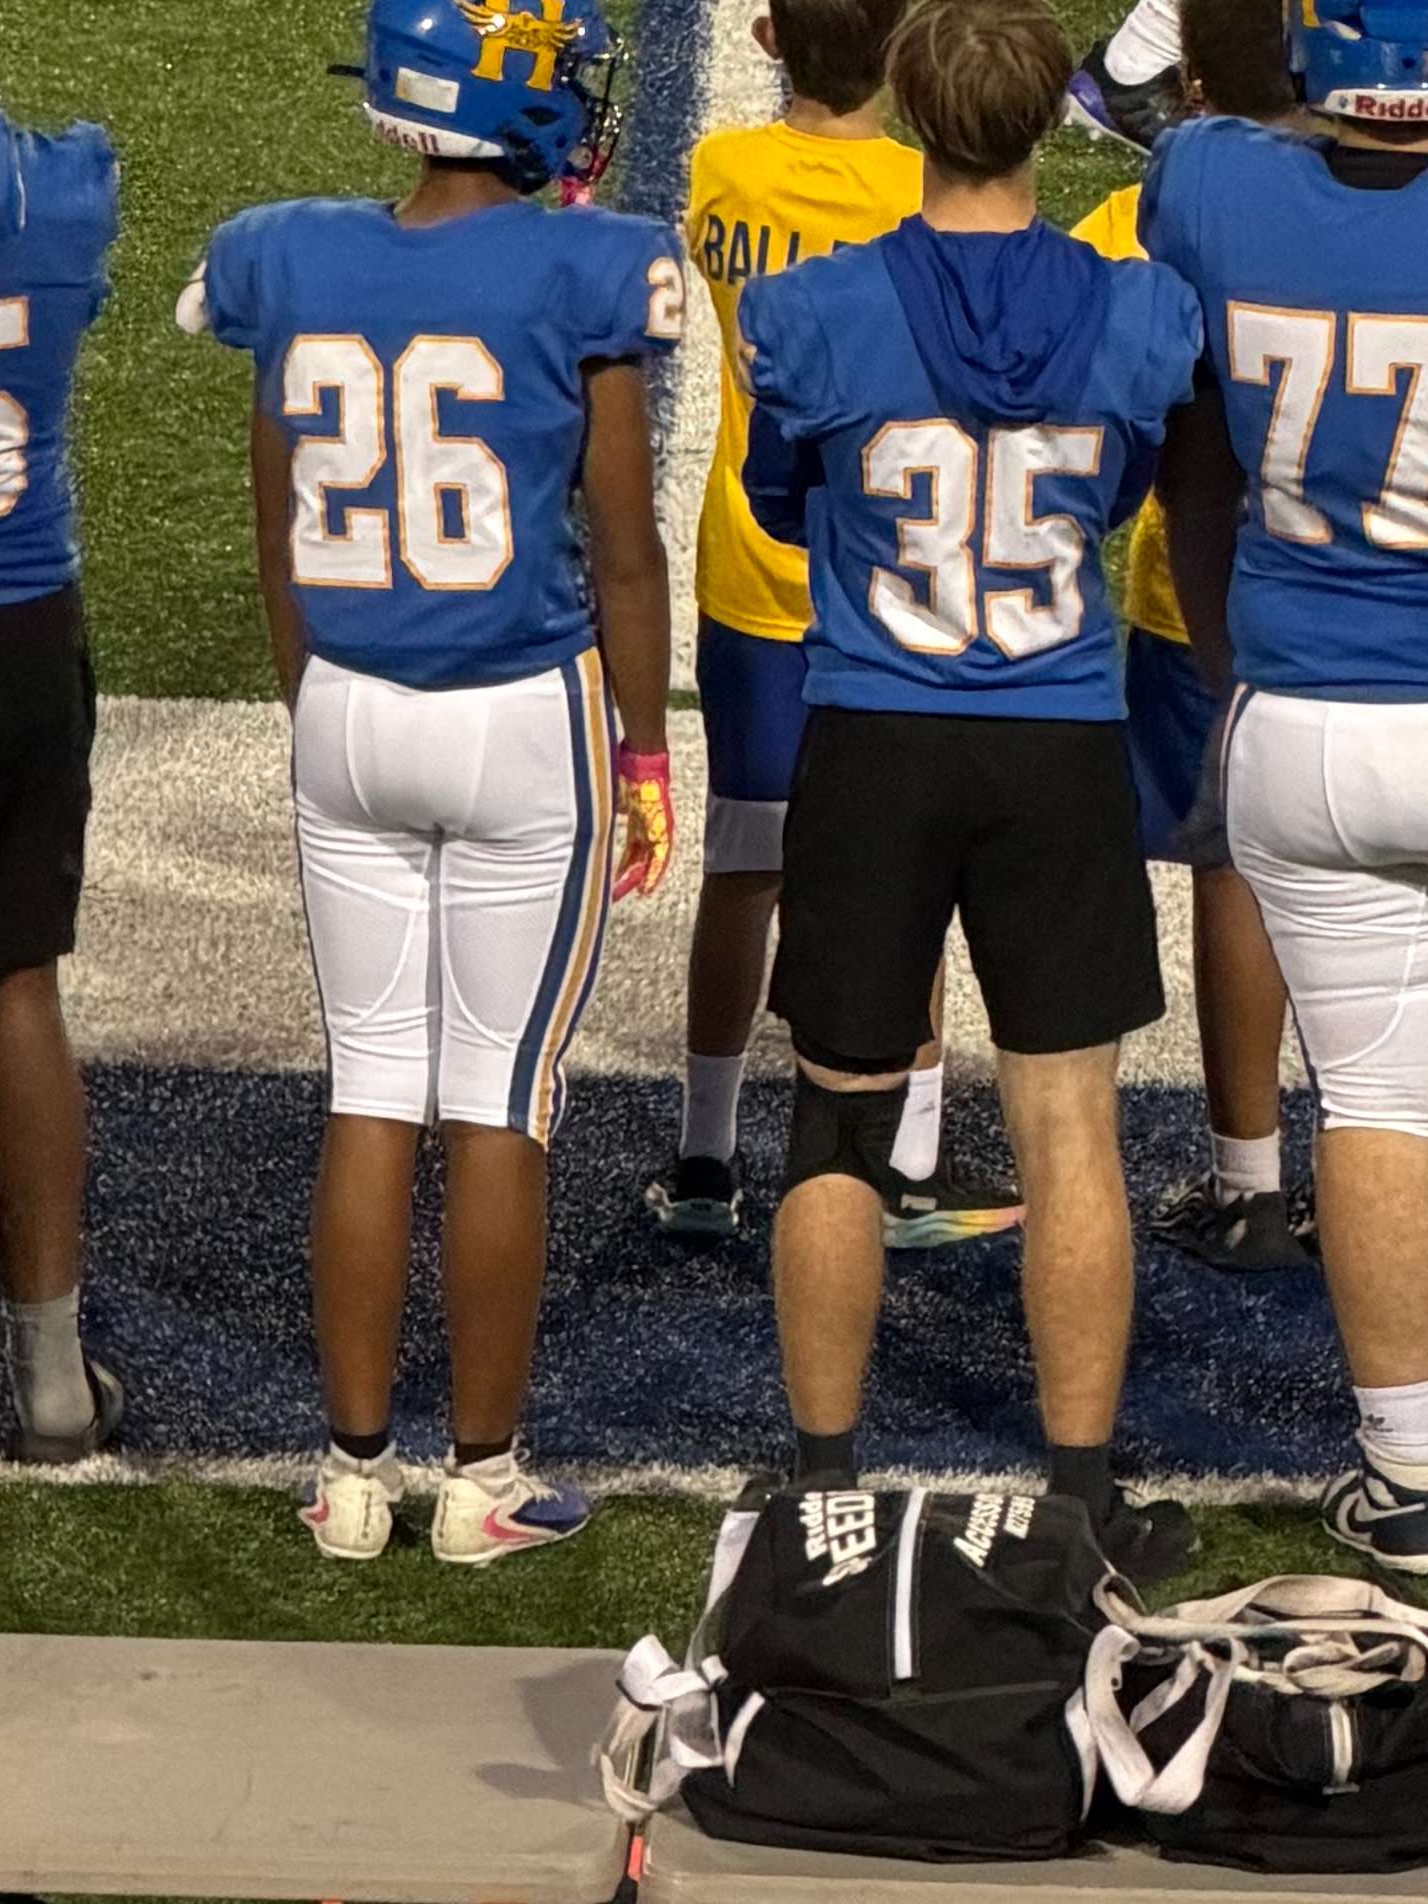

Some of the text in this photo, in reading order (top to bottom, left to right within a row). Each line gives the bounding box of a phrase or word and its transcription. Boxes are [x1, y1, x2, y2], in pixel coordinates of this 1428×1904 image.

[643, 255, 684, 339] 2
[281, 333, 515, 591] 26
[861, 418, 1104, 659] 35
